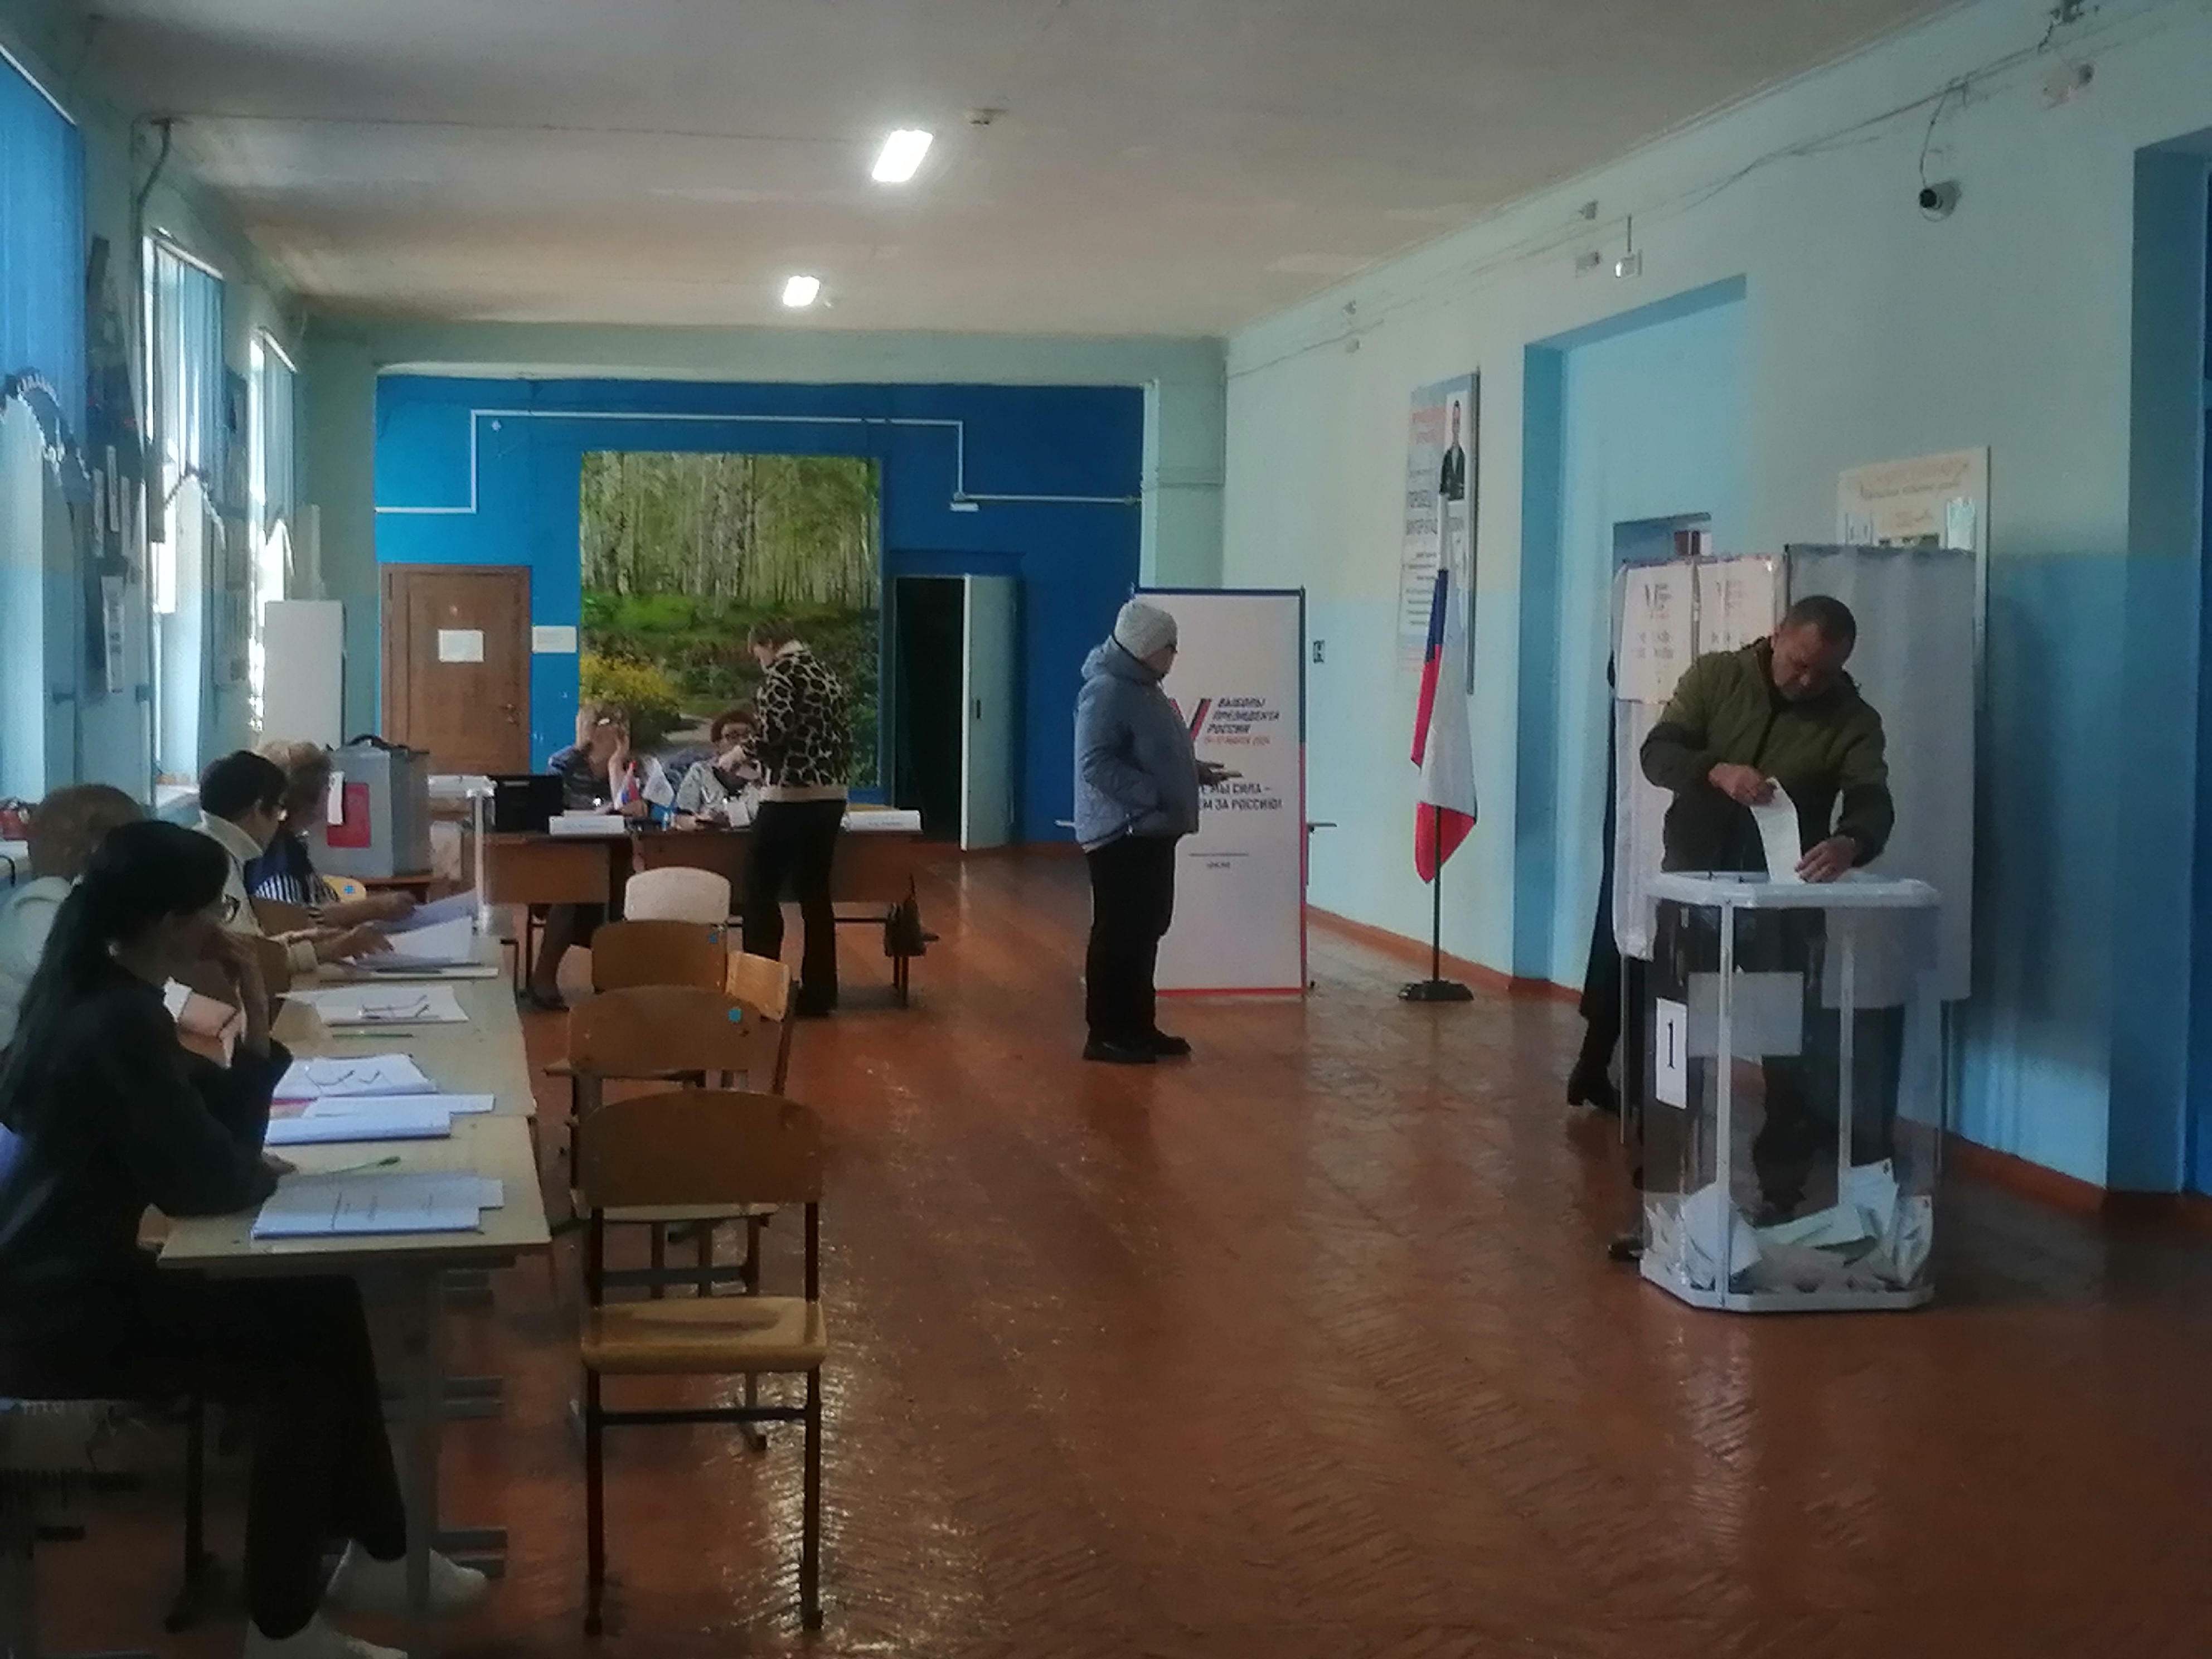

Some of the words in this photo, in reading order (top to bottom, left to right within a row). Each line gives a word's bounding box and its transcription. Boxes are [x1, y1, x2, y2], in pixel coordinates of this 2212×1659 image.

[1218, 697, 1266, 708] ВЫБОРЫ
[1212, 710, 1279, 721] ПРЕЗИДЕНТА
[1207, 724, 1251, 734] РОССИИ
[1215, 799, 1229, 810] ЗА
[1667, 1018, 1675, 1069] 1
